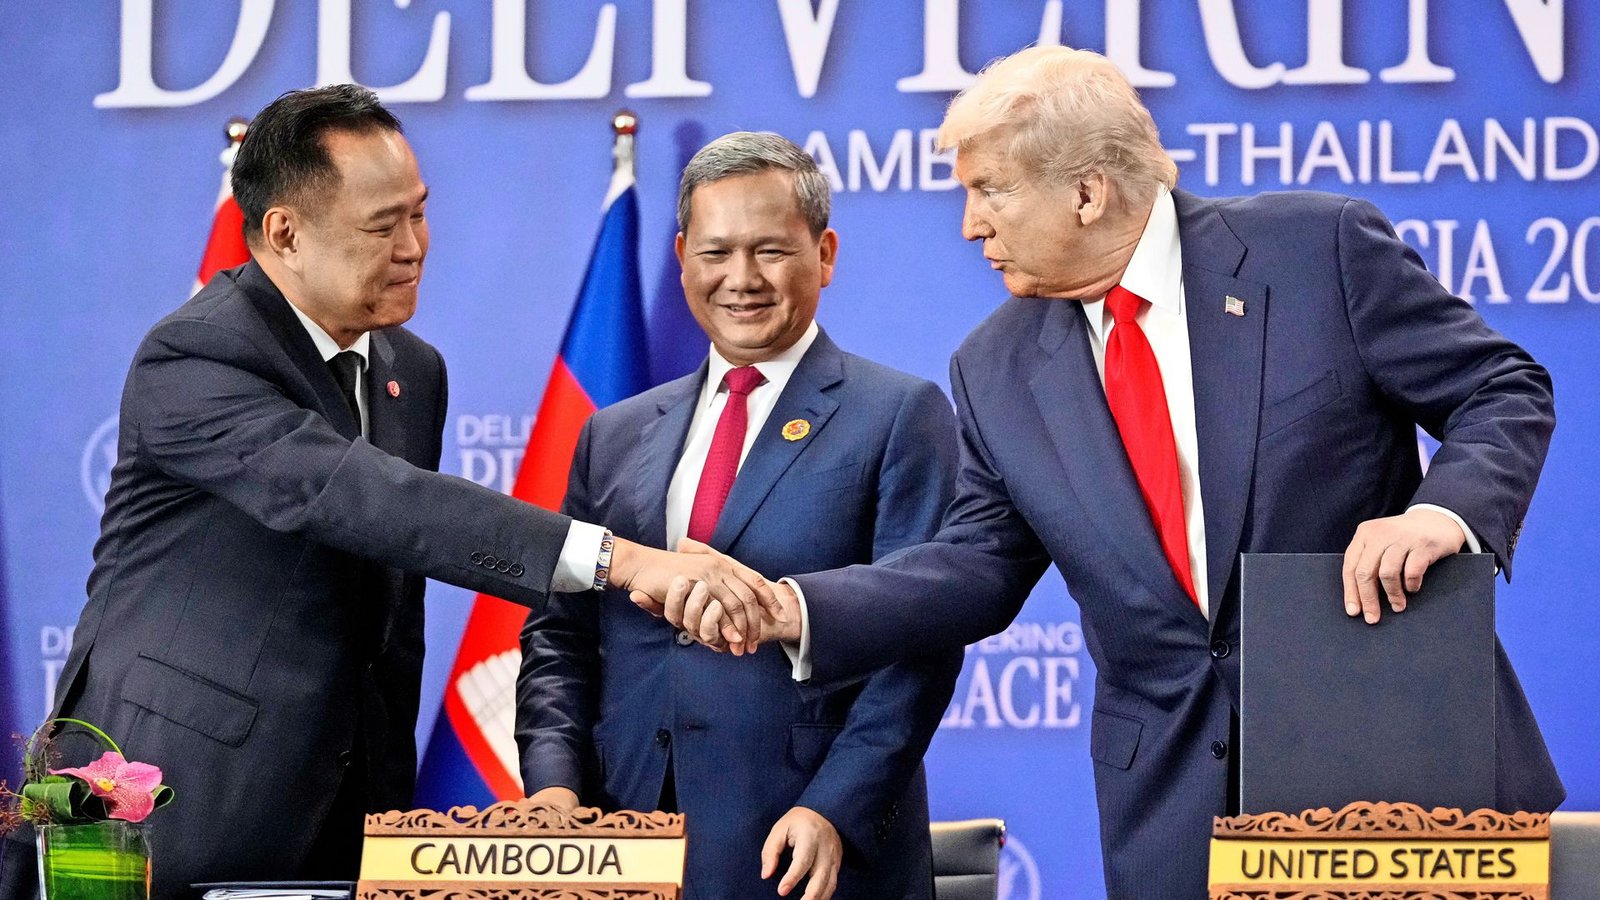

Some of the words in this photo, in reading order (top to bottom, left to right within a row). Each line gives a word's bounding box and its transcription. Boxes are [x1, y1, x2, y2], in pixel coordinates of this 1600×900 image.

[967, 622, 1082, 654] ERING
[410, 842, 623, 876] CAMBODIA
[1240, 848, 1379, 879] UNITED
[1389, 847, 1517, 879] STATES
